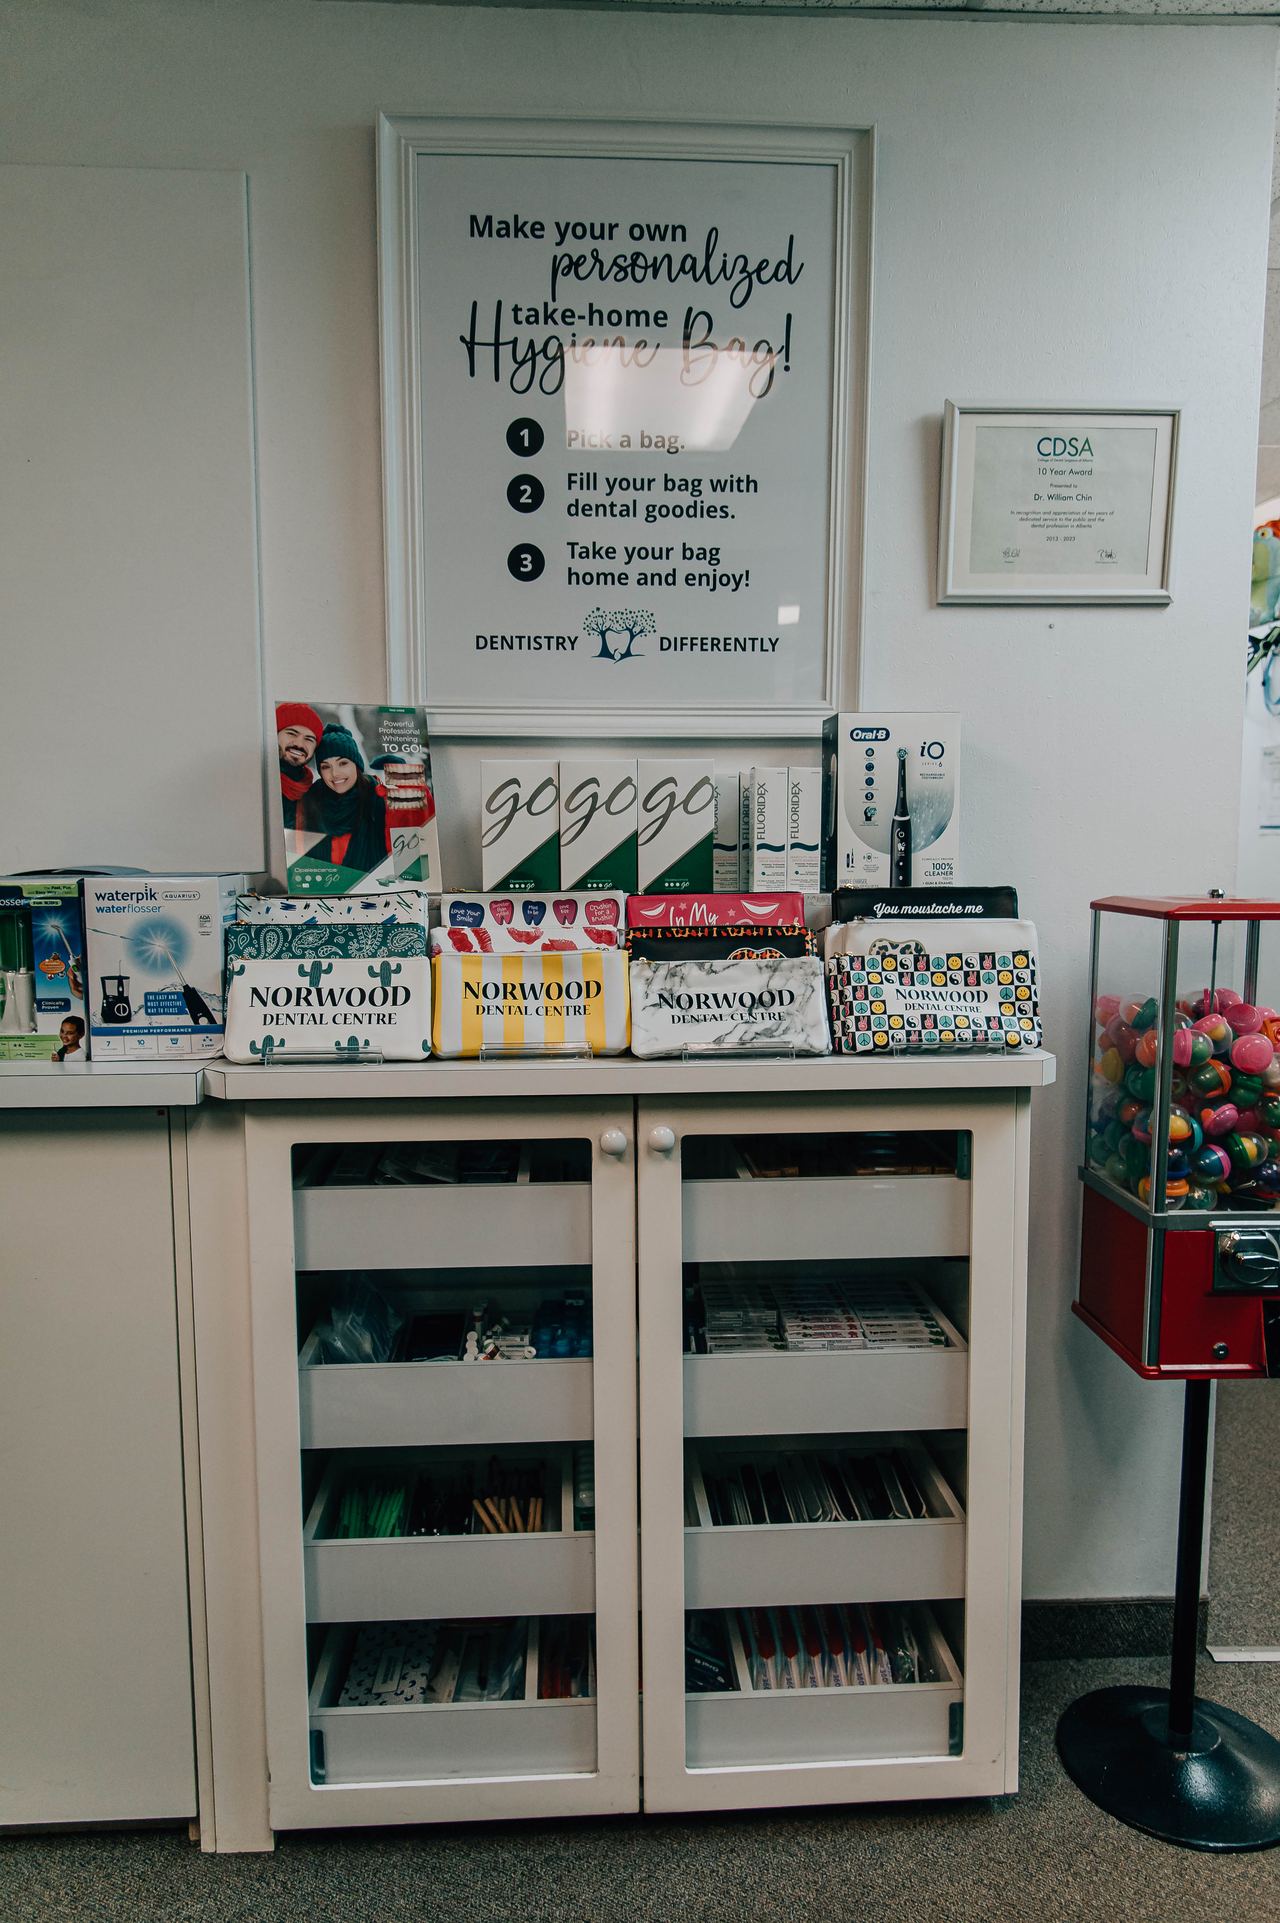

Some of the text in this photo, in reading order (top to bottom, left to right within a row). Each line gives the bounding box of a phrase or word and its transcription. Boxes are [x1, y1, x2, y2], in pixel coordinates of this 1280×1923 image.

[469, 215, 687, 245] Make your own
[551, 226, 805, 309] personalized
[512, 302, 669, 327] take-home
[459, 299, 793, 399] Hygiene Bag!
[519, 428, 685, 455] 1 Pick a bag.
[1037, 437, 1094, 456] CDSA
[1069, 468, 1092, 476] Award
[519, 472, 759, 503] 2 Fill your bag with
[566, 500, 736, 524] dental goodies.
[520, 541, 721, 572] 3 Take your bag
[566, 568, 751, 592] home and enjoy!
[475, 634, 780, 653] DENTISTRY DIFFERENTLY
[853, 730, 886, 739] Oral-B
[382, 744, 421, 752] TO GO!
[920, 742, 944, 759] iO
[482, 777, 559, 848] go
[561, 776, 637, 847] go
[638, 775, 715, 847] go
[757, 782, 769, 840] FLUORIDEX
[791, 782, 802, 839] FLUORIDEX
[95, 883, 158, 903] waterpik
[689, 902, 719, 926] My
[874, 903, 984, 918] You moustache me
[249, 986, 411, 1008] NORWOOD
[463, 980, 602, 1000] NORWOOD
[657, 989, 795, 1010] NORWOOD
[895, 989, 988, 1004] NORWOOD
[262, 1012, 397, 1026] DENTAL CENTRE
[476, 1004, 591, 1016] DENTAL CENTRE
[671, 1011, 786, 1024] DENTAL CENTRE
[904, 1003, 982, 1013] DENTAL CENTRE
